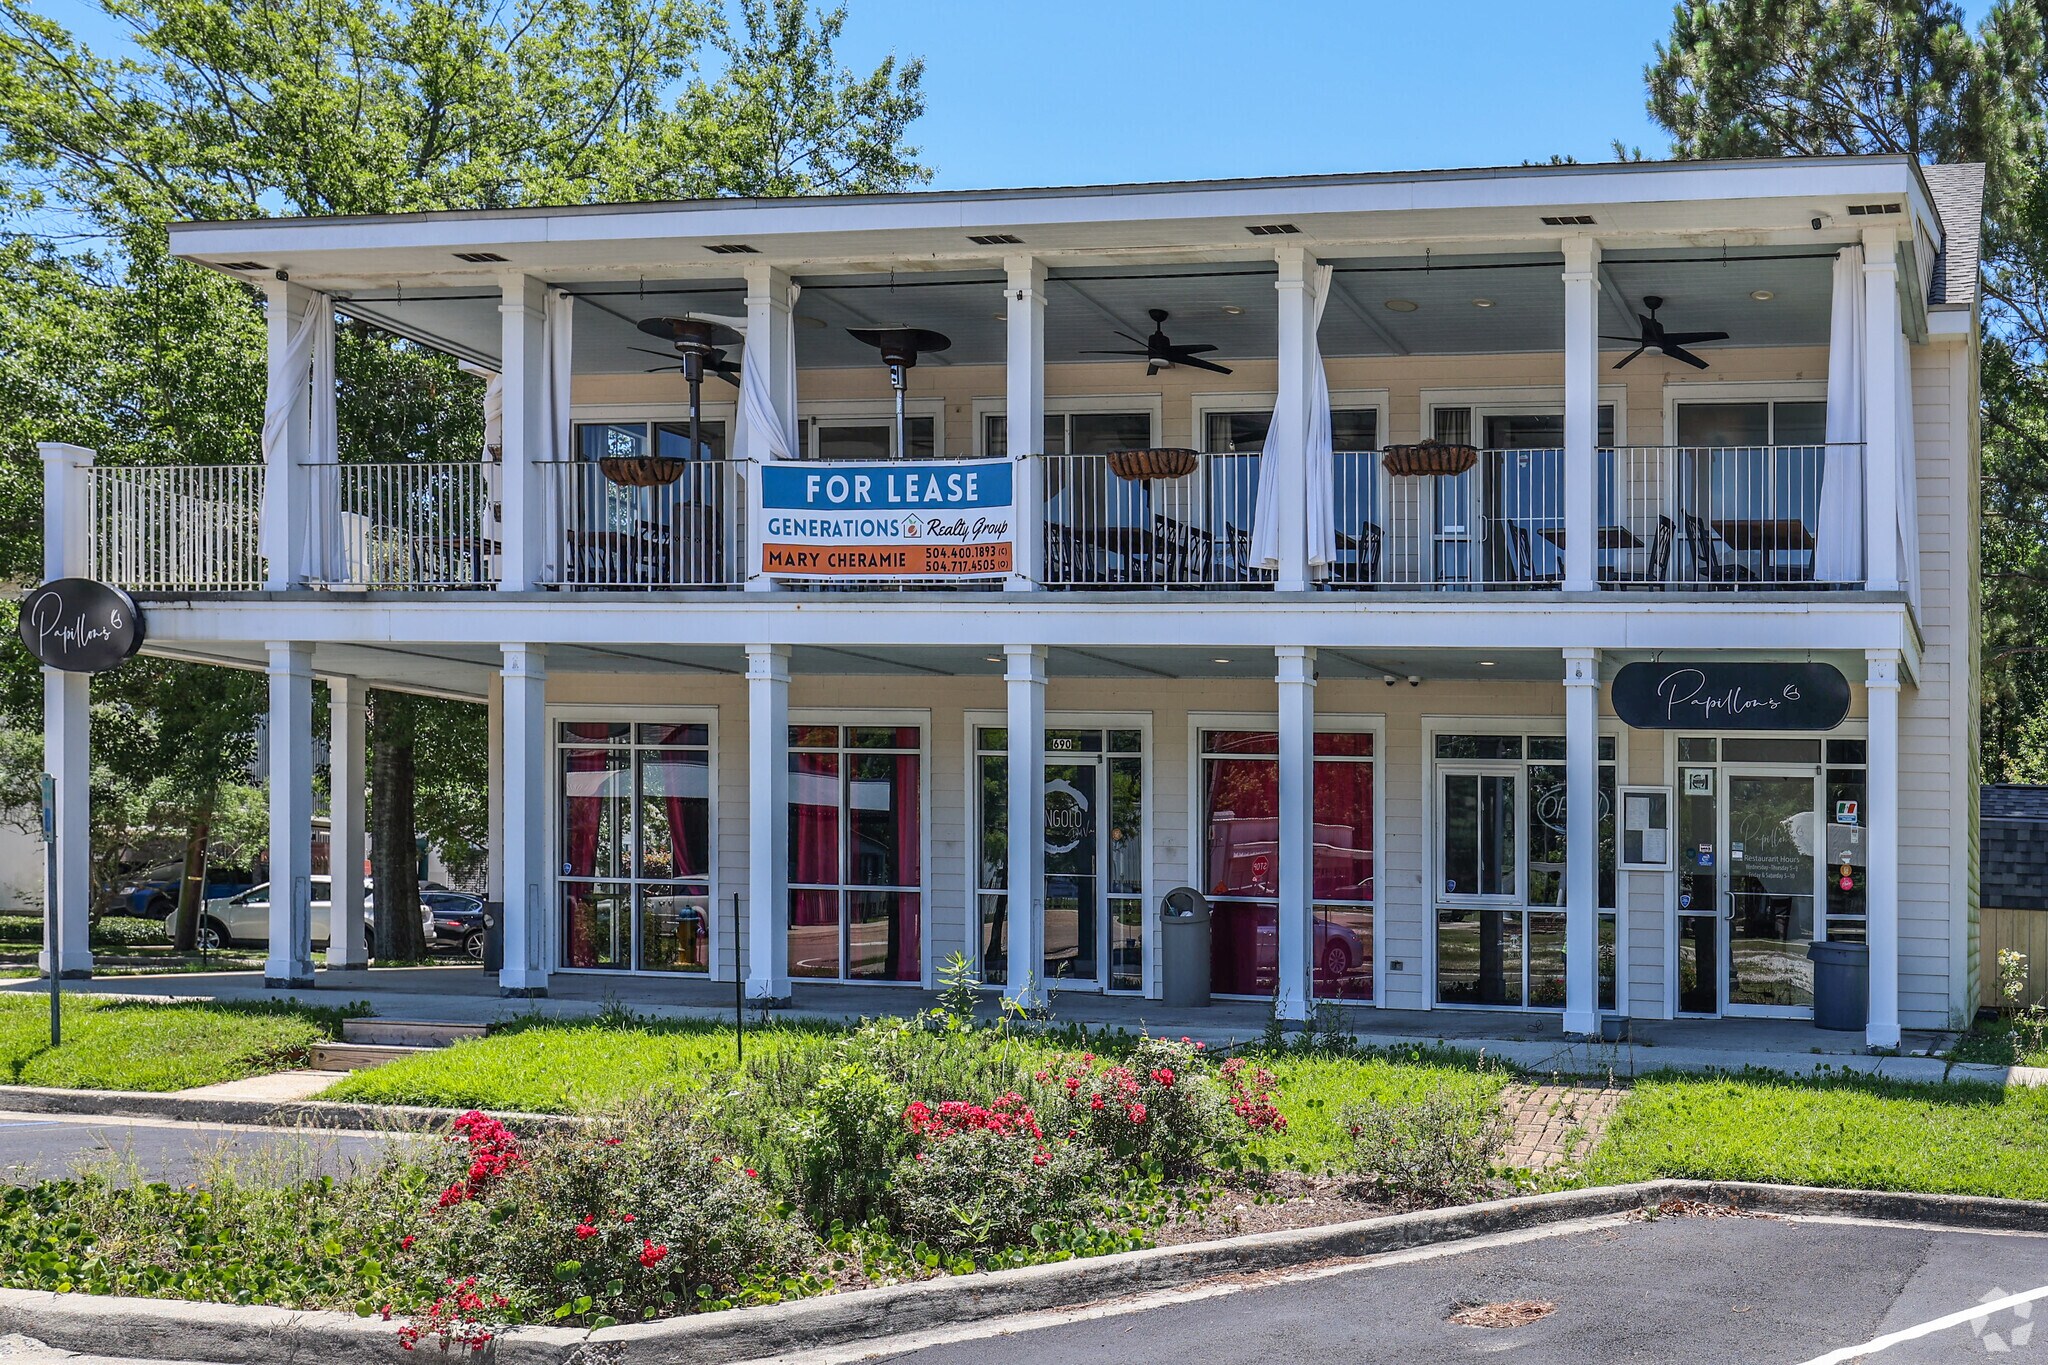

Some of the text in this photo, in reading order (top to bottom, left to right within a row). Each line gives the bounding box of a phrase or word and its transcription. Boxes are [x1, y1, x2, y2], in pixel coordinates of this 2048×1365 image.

[807, 472, 979, 503] FOR LEASE
[768, 516, 1008, 542] GENERATIONS Realty Group
[769, 551, 906, 567] MARY CHERAMIE
[926, 546, 1008, 559] 504.400.1893 (C)
[926, 559, 996, 572] 504.717.4505
[1053, 740, 1071, 749] 690
[1744, 854, 1779, 863] Restaurant
[1780, 855, 1800, 864] Hours
